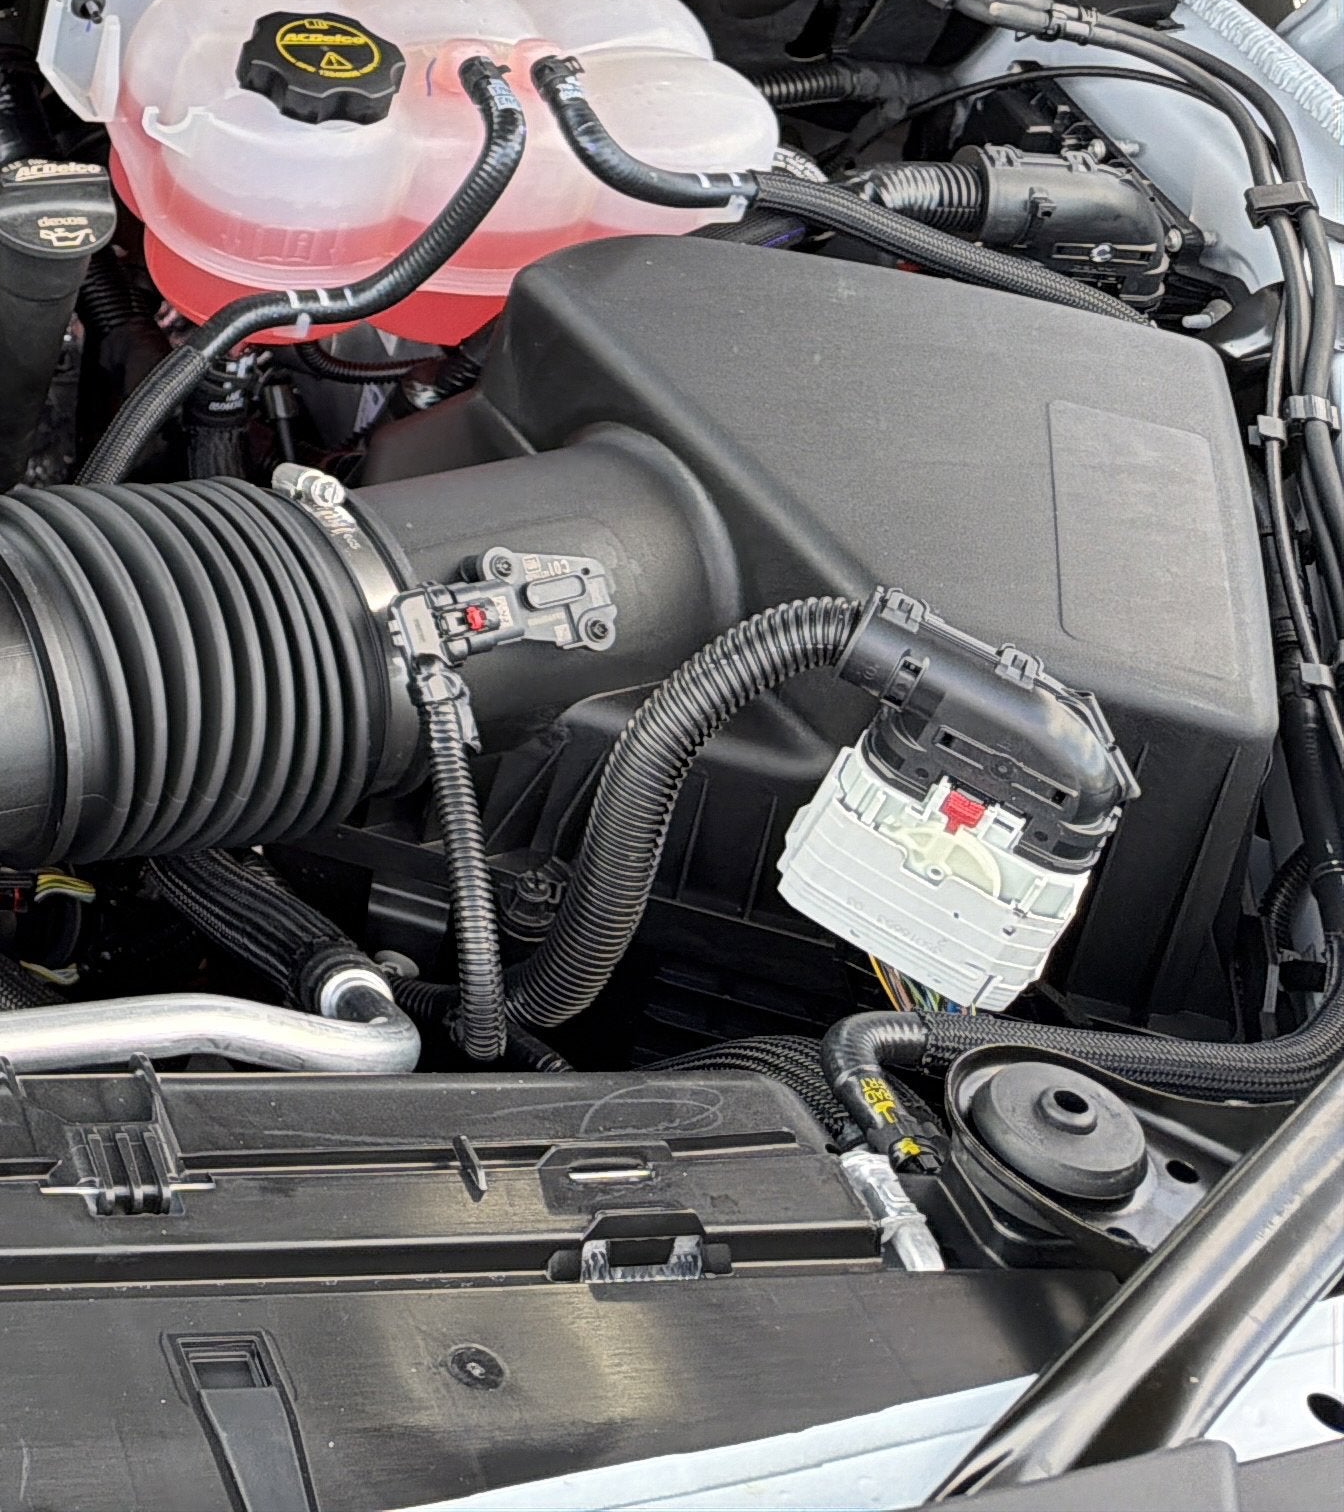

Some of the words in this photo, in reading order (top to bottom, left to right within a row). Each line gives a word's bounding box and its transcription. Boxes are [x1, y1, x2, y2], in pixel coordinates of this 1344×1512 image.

[282, 33, 367, 44] ACDelco
[15, 162, 101, 181] ACDelco
[37, 216, 88, 228] dexos
